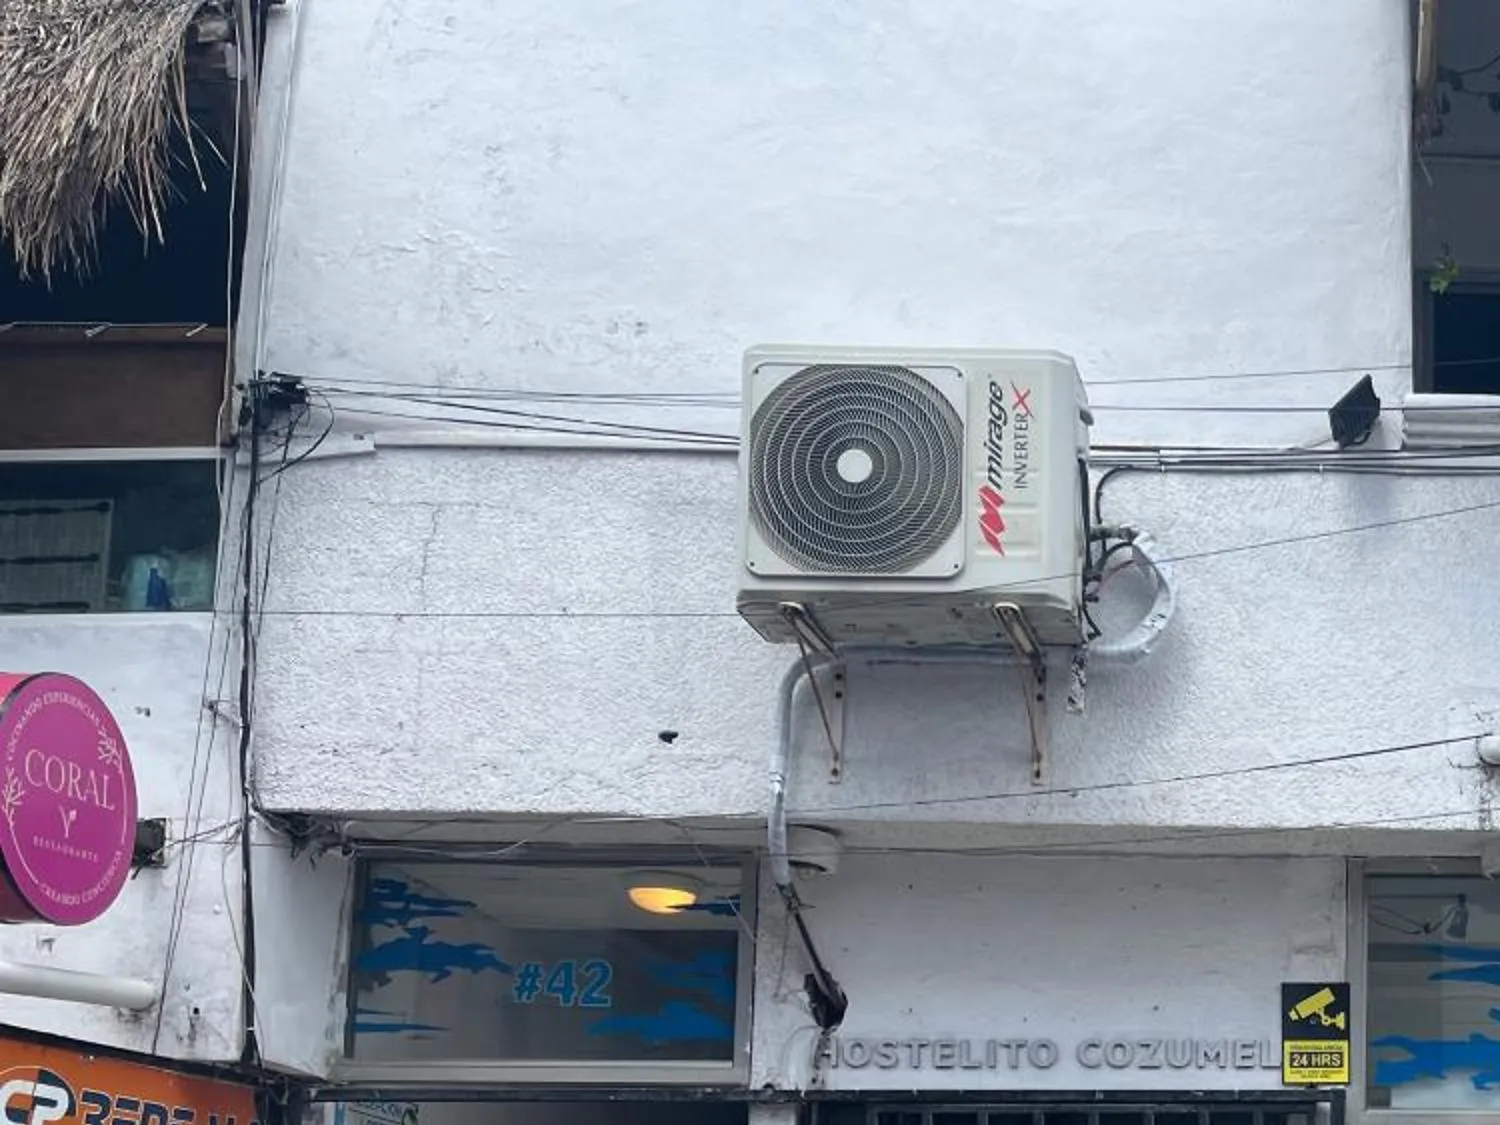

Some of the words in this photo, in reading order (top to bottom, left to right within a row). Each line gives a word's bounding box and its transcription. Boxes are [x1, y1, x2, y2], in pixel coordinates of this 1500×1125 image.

[983, 380, 1008, 489] mirage
[1013, 413, 1029, 488] INVERTER
[25, 748, 115, 811] CORAL
[512, 957, 613, 1008] #42
[816, 1036, 1059, 1069] HOSTELITO
[1076, 1037, 1282, 1069] COZUMEL
[1292, 1054, 1309, 1067] 24
[1311, 1054, 1341, 1067] HRS
